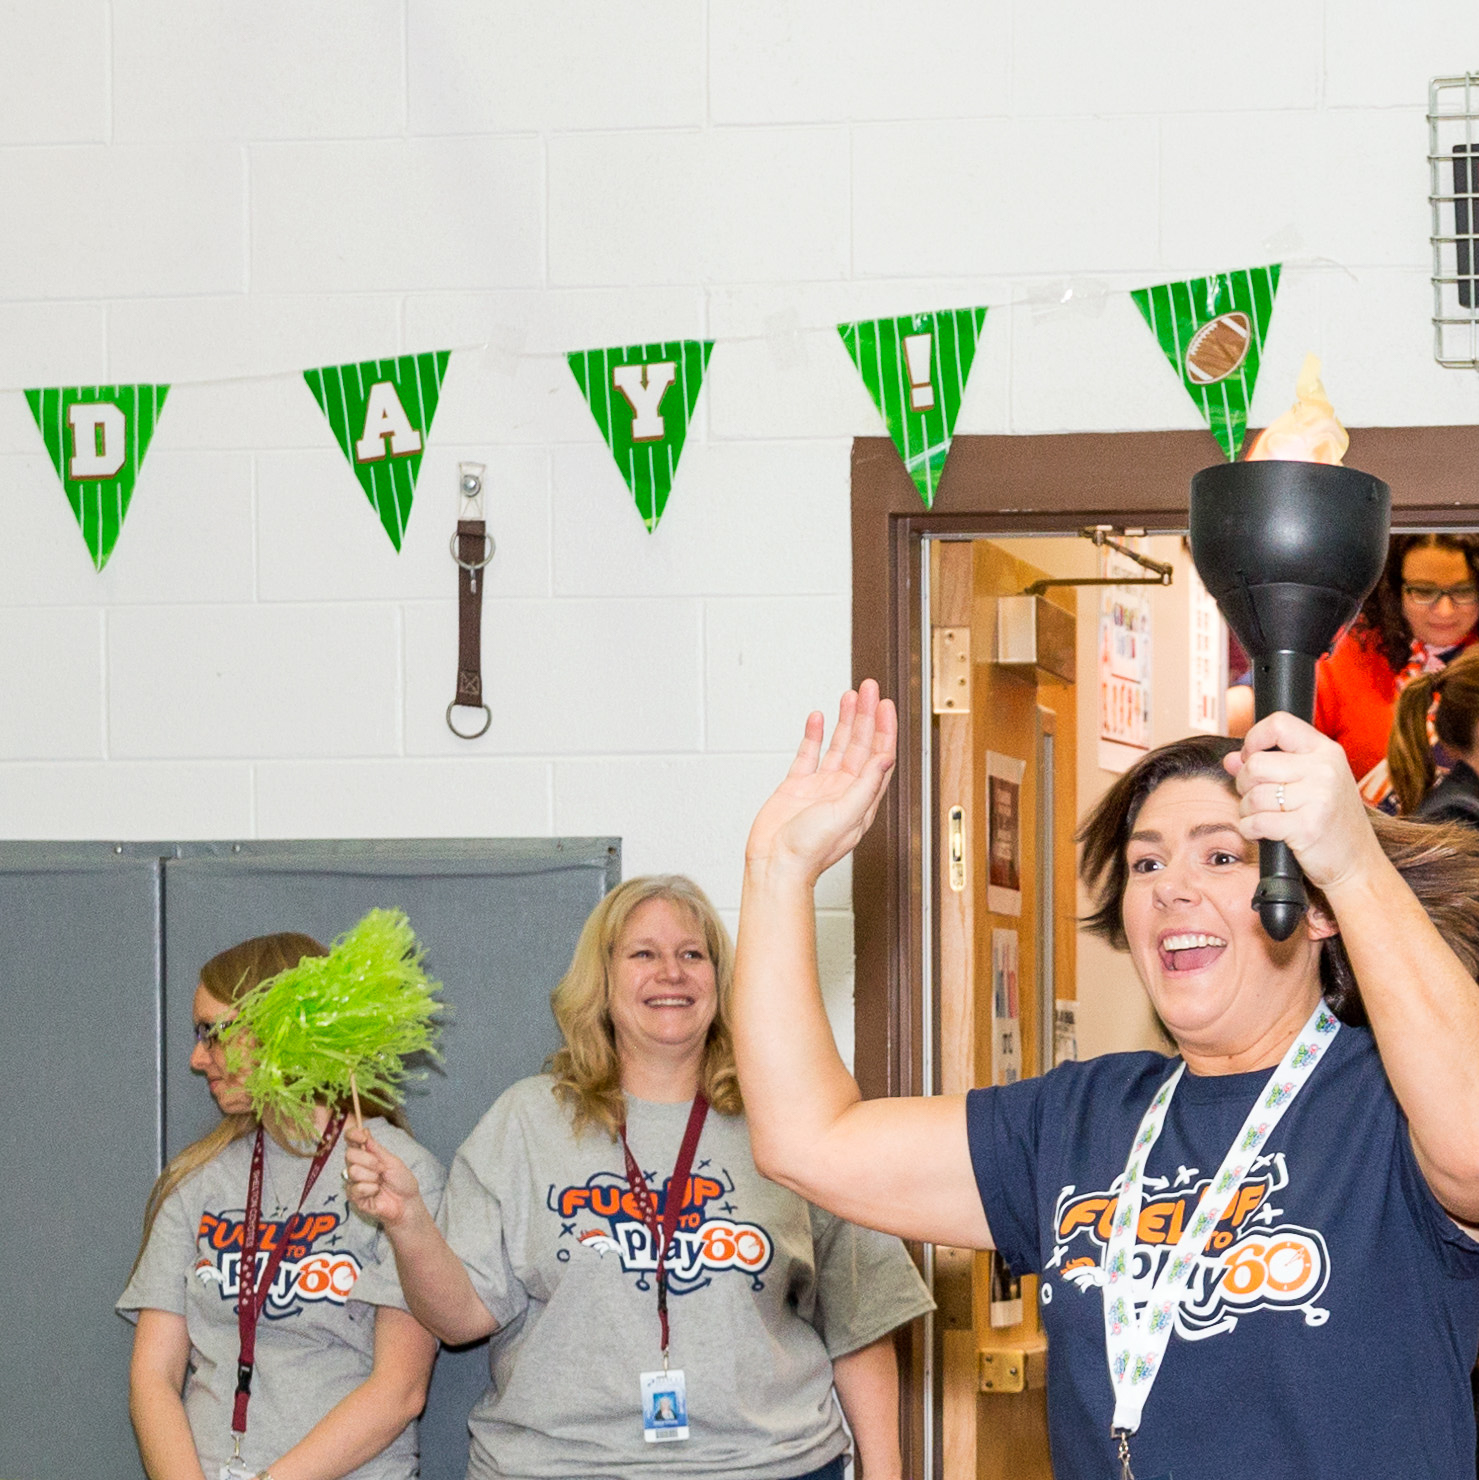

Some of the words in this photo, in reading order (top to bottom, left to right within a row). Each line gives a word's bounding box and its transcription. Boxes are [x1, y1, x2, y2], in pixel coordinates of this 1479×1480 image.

[679, 1212, 702, 1229] TO
[199, 1213, 280, 1251] FUL
[288, 1214, 337, 1242] UP
[1206, 1230, 1233, 1251] TO
[286, 1245, 306, 1258] TO
